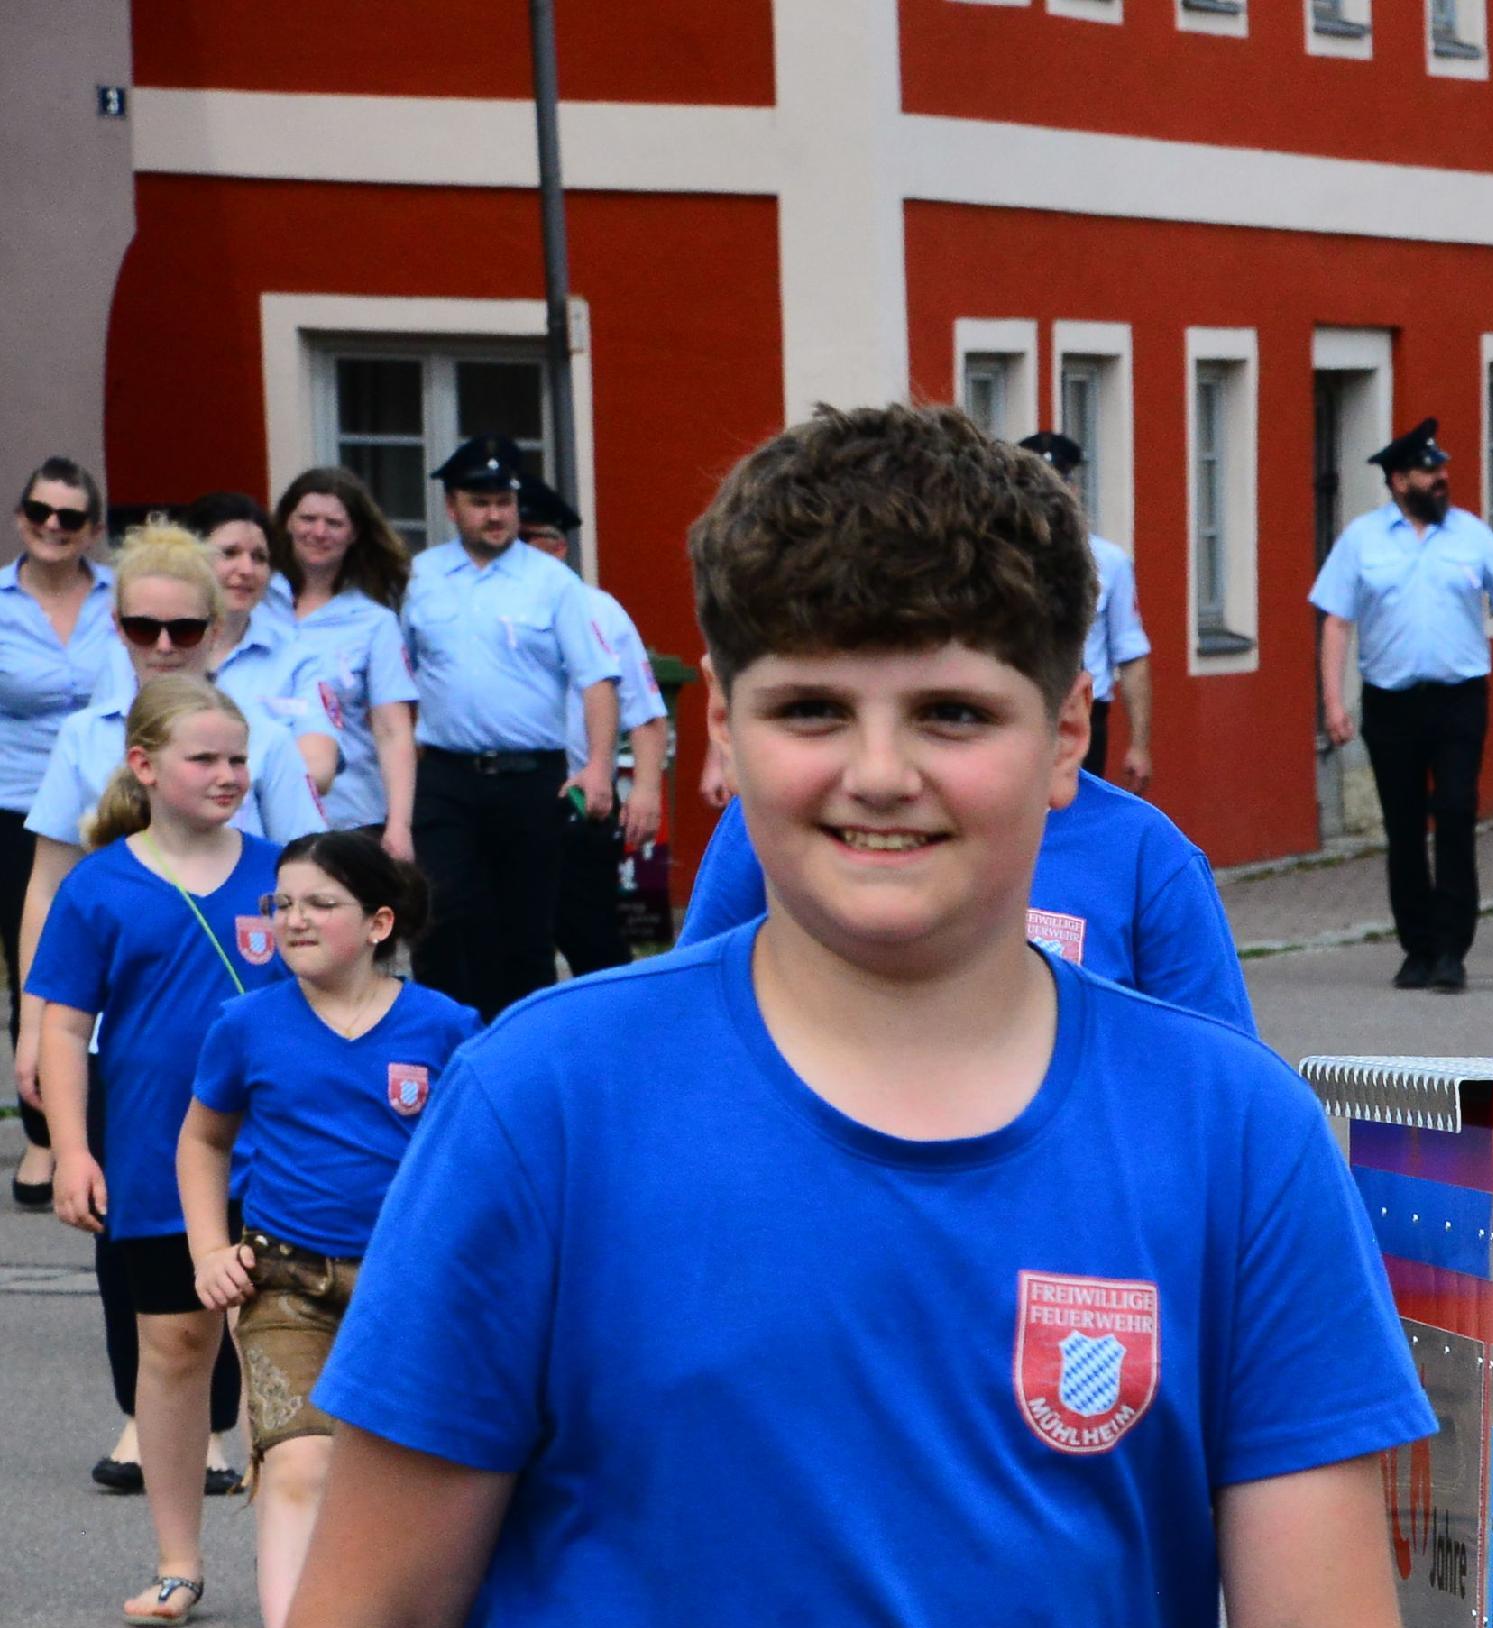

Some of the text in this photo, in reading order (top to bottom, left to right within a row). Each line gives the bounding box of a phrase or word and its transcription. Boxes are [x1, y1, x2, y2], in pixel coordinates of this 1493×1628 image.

[1027, 924, 1080, 942] UERWEHR
[1028, 912, 1080, 931] EIWILLIGE
[1030, 1281, 1153, 1309] FREIWILLIGE
[1030, 1305, 1153, 1332] FEUERWEHR
[1027, 1396, 1135, 1445] MÜHLHEIM
[1429, 1505, 1467, 1600] Jahre
